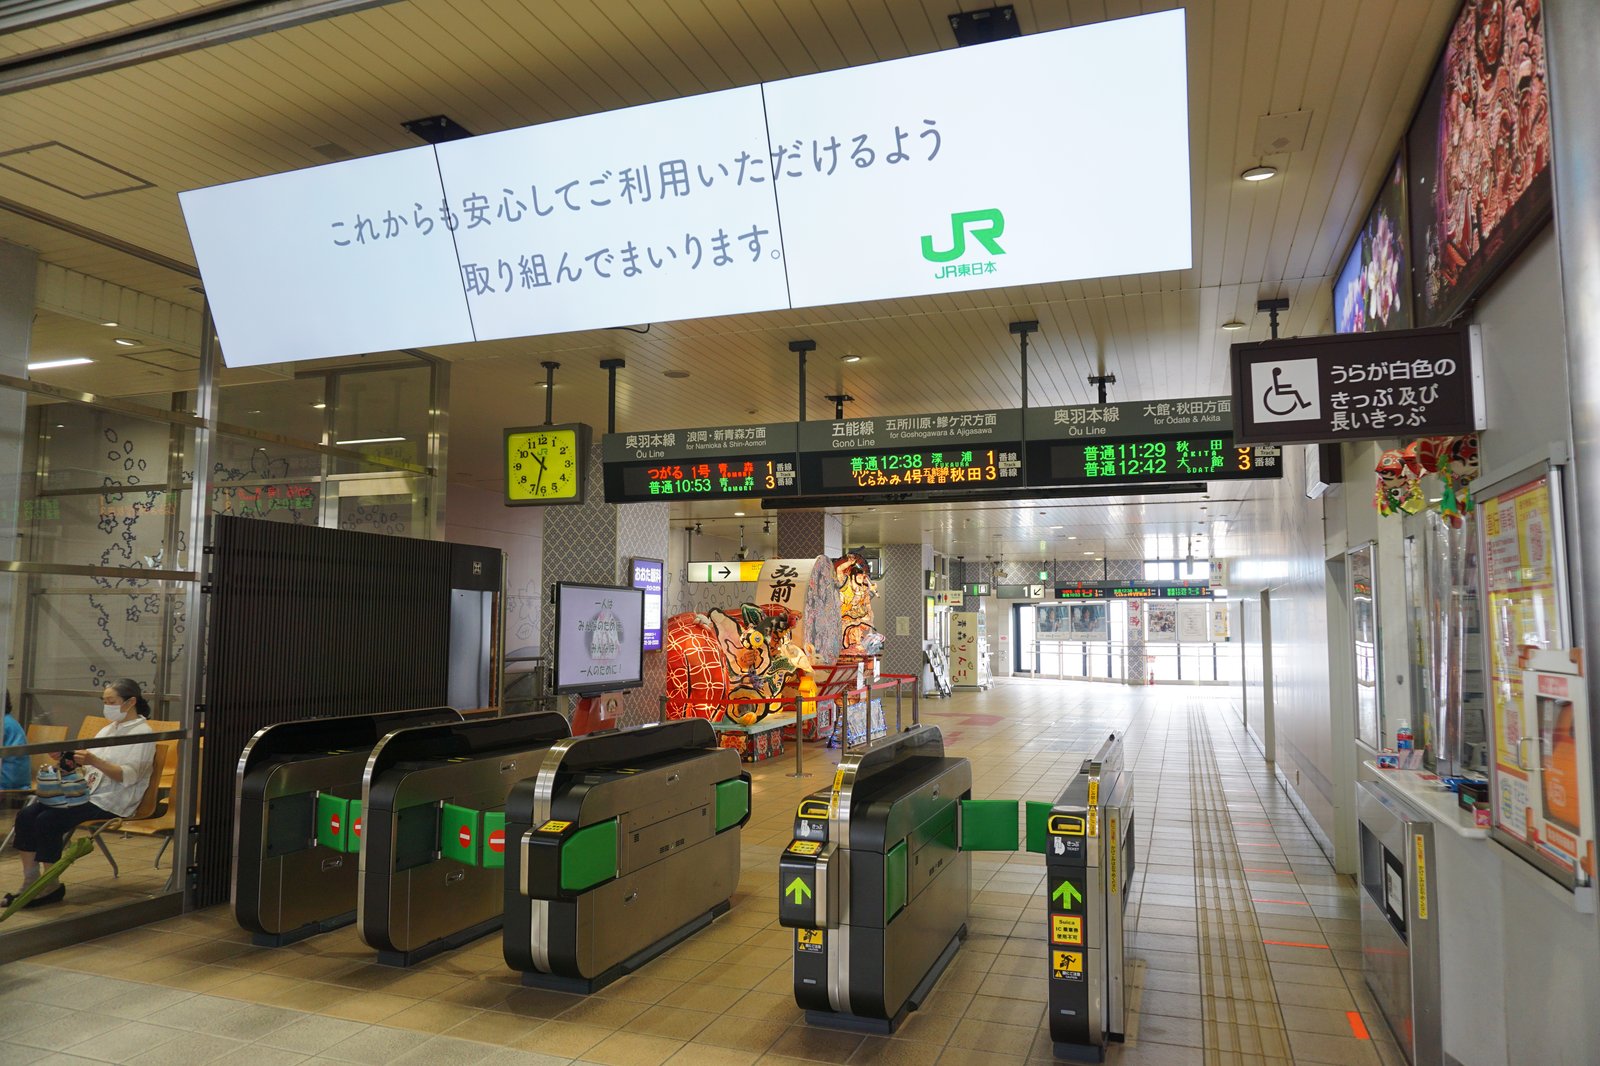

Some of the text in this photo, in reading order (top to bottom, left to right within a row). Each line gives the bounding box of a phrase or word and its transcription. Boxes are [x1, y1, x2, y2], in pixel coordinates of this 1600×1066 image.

[331, 119, 942, 246] これからも安心してご利用いただけるよう
[920, 208, 1007, 263] JR
[461, 224, 780, 295] 取り組んでまいります。
[934, 261, 997, 279] JR東日本
[1330, 358, 1456, 384] うらが白色の
[1330, 383, 1439, 410] きっぷ 及び
[1053, 406, 1120, 425] 奥羽本線
[1143, 400, 1232, 417] 大館・秋田方面
[1154, 417, 1164, 425] for
[1192, 415, 1198, 423] &
[1201, 414, 1221, 423] Akita
[1330, 406, 1427, 432] 長いきっぷ
[686, 427, 767, 442] 浪岡・新青森方面
[831, 421, 874, 437] 五能線
[889, 431, 900, 439] for
[901, 430, 948, 440] Goshogawara
[956, 427, 993, 437] Ajigasawa
[1085, 425, 1106, 435] Line
[528, 441, 536, 449] 11
[538, 437, 547, 445] 12
[552, 439, 555, 447] 1
[626, 432, 675, 449] 奥羽本線
[695, 442, 722, 450] Namioka
[729, 440, 767, 448] Shin-Aomori
[857, 438, 876, 447] Line
[520, 450, 528, 458] 10
[560, 447, 566, 455] 2
[649, 450, 665, 458] Line
[1083, 444, 1116, 461] 普通
[1118, 442, 1166, 459] 11:29
[516, 463, 522, 471] 9
[565, 460, 571, 468] 3
[850, 456, 879, 471] 普通
[881, 454, 923, 470] 12:38
[986, 450, 994, 465] 1
[1083, 460, 1116, 477] 普通
[1118, 458, 1167, 475] 12:42
[1238, 454, 1251, 470] 3
[560, 473, 566, 481] 4
[647, 465, 683, 479] つがる
[691, 464, 711, 479] 1号
[766, 461, 773, 475] 1
[950, 465, 997, 482] 秋田 3
[521, 476, 527, 484] 8
[675, 478, 712, 493] 10:53
[765, 475, 775, 489] 3
[858, 469, 923, 487] しらかみ 4号
[530, 484, 536, 492] 7
[541, 486, 546, 494] 6
[769, 564, 799, 603] 弘前
[963, 585, 967, 593] 1
[1023, 586, 1028, 597] 1
